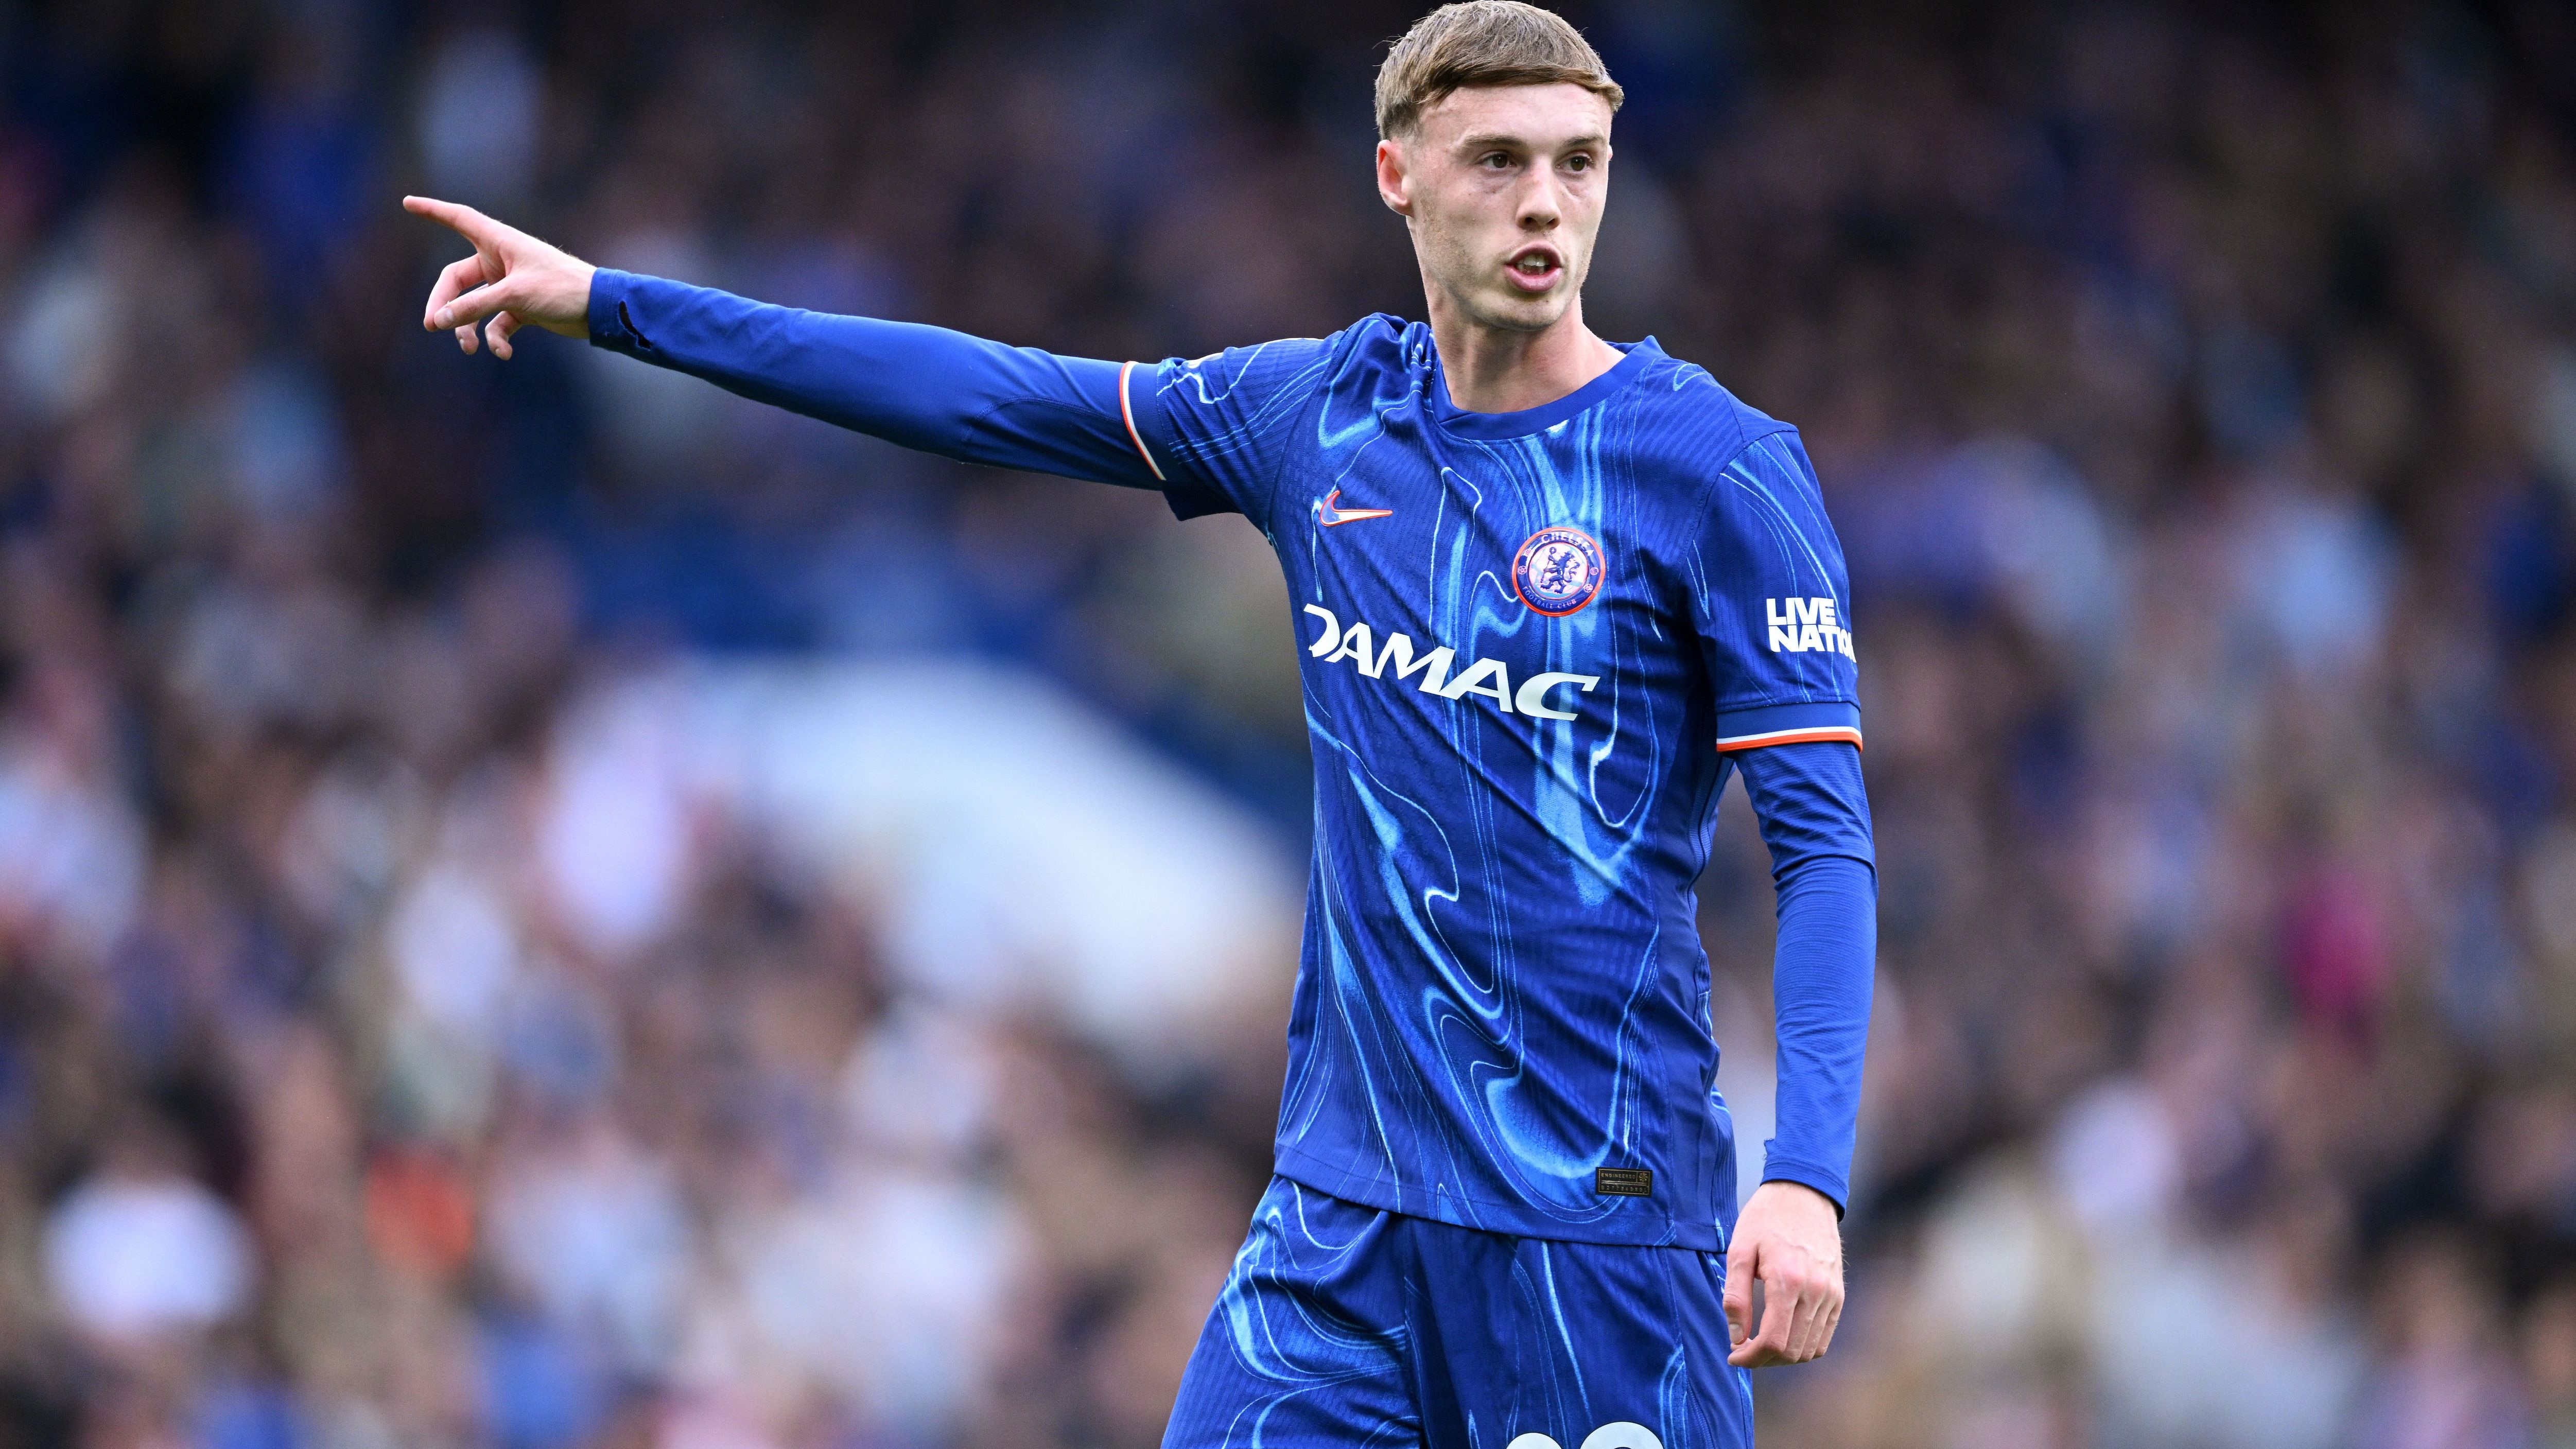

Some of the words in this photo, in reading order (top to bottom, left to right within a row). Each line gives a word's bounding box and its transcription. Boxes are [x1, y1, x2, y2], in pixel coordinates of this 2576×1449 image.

[1541, 532, 1594, 556] CHELSEA
[1522, 586, 1554, 609] FOOTBALL
[1557, 599, 1577, 609] CLUB
[1766, 597, 1836, 625] LIVE
[1303, 603, 1600, 721] DAMAC
